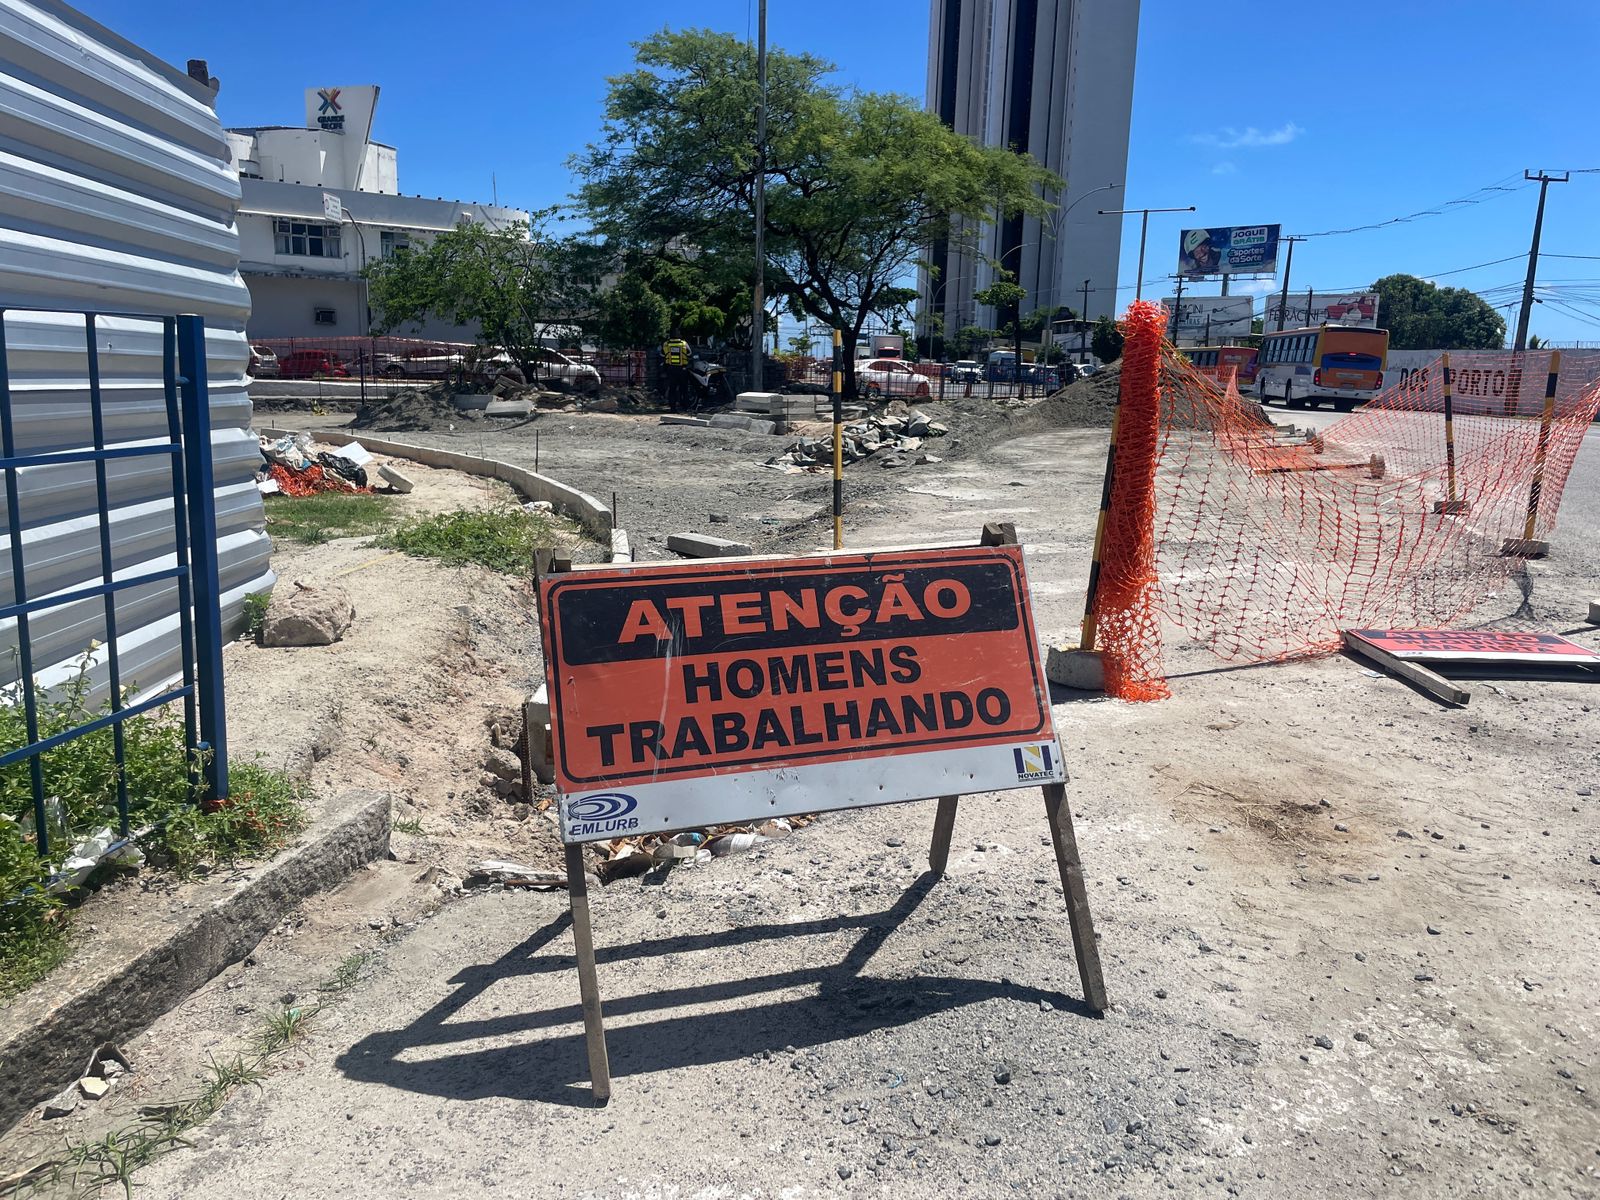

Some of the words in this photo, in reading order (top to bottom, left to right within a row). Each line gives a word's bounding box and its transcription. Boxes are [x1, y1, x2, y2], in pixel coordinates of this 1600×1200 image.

[1233, 228, 1265, 238] JOGUE
[1229, 256, 1239, 264] da
[1240, 254, 1262, 263] Sorte
[1399, 368, 1430, 393] DOS
[617, 574, 973, 643] ATENÇÃO
[682, 644, 922, 704] HOMENS
[586, 686, 1012, 768] TRABALHANDO
[1018, 770, 1054, 779] NOVATEC
[571, 817, 639, 836] EMLURB
